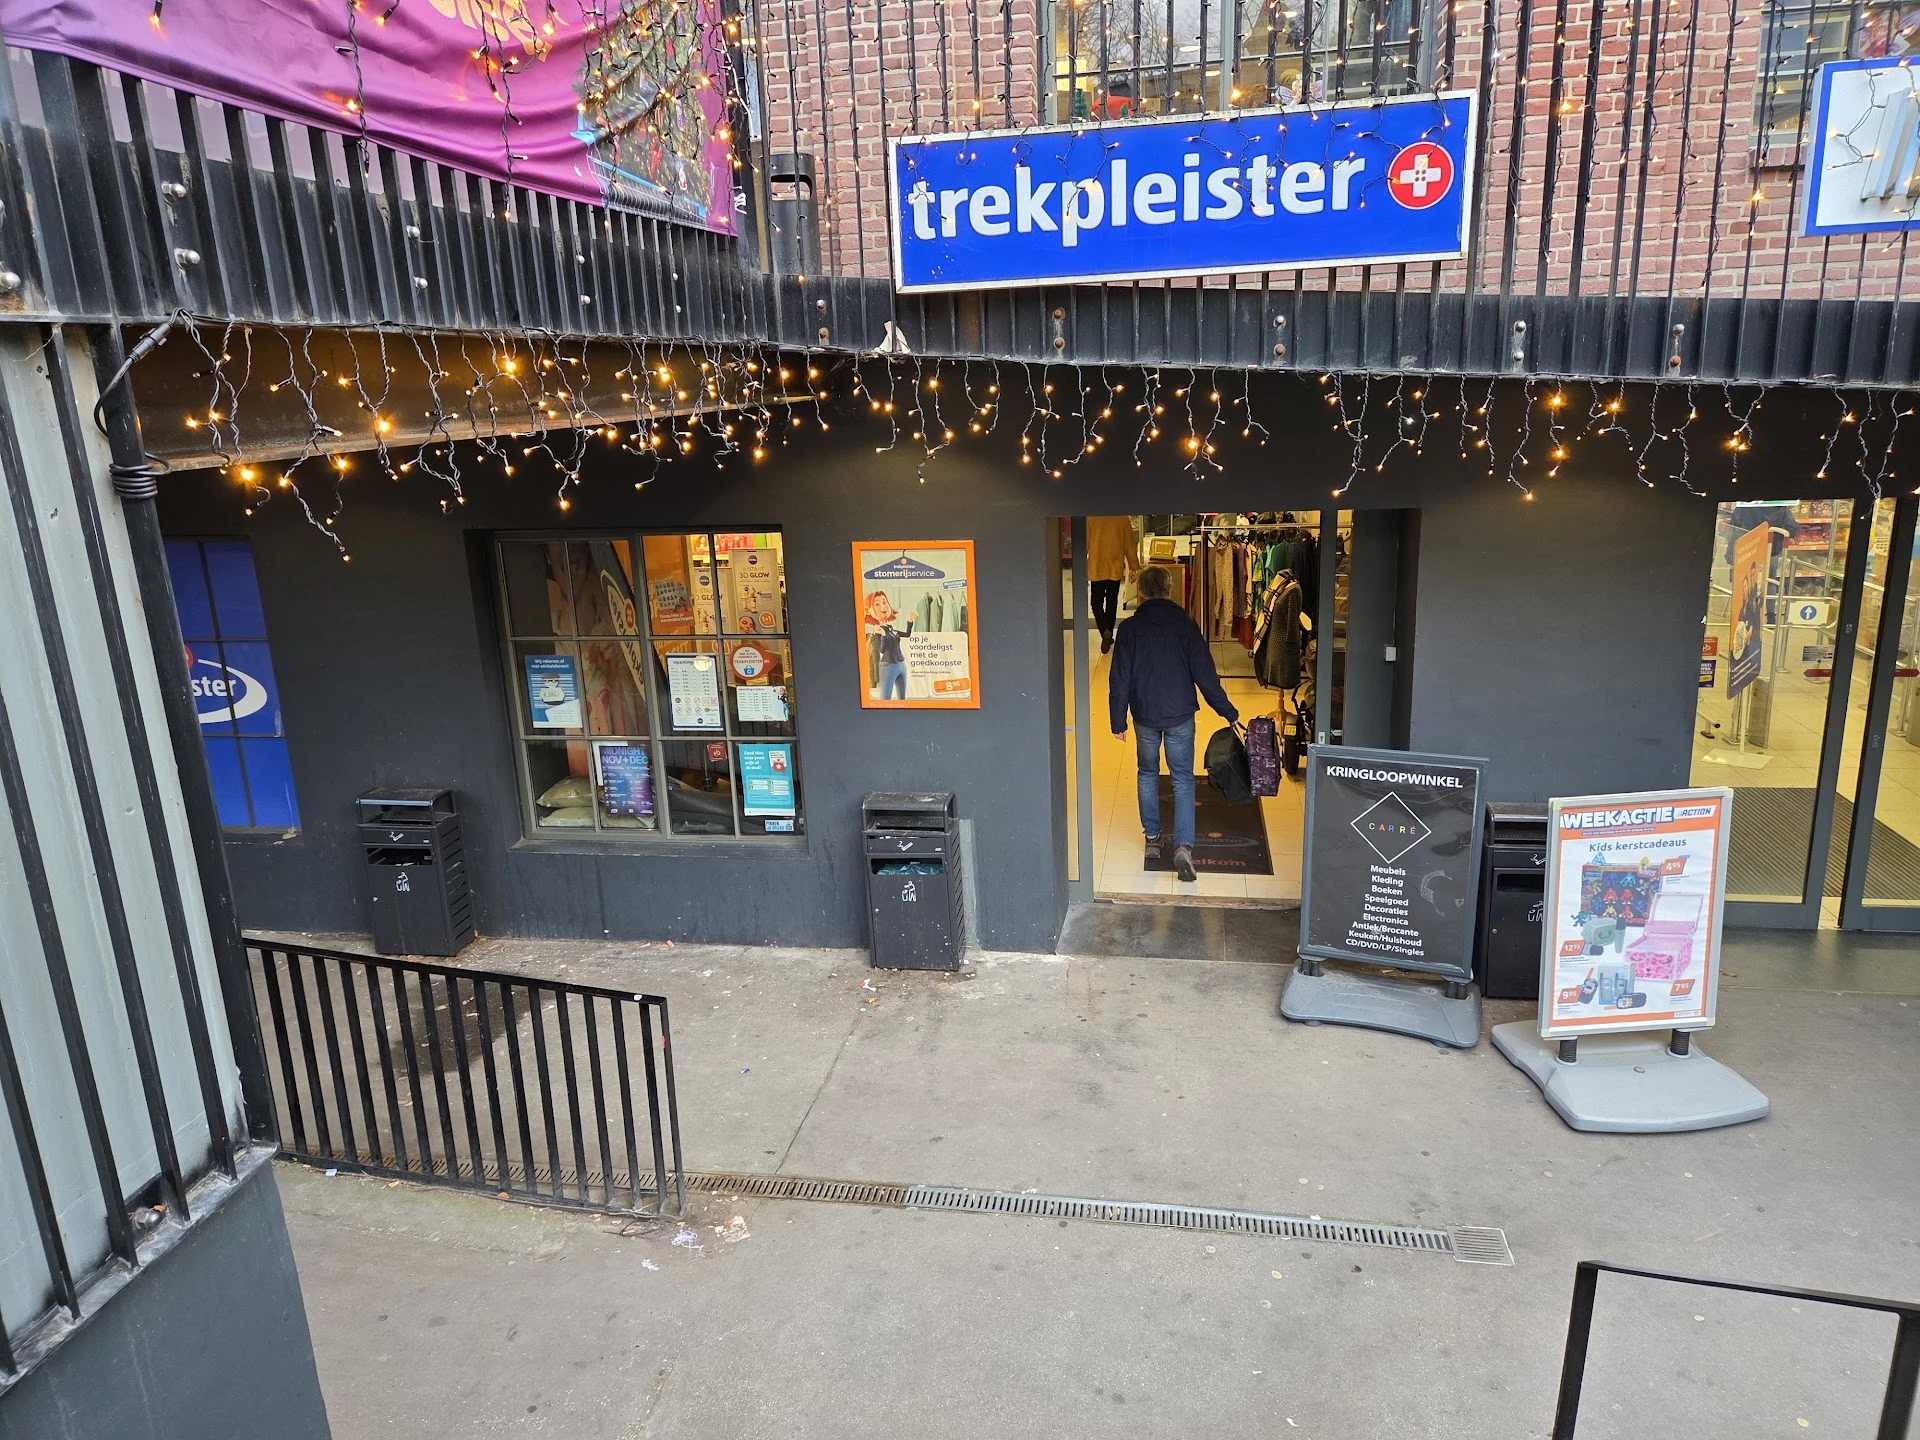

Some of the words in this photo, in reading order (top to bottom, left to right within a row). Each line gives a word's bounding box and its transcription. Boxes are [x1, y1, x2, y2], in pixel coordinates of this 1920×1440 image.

[908, 152, 1366, 248] trekpleister
[874, 570, 934, 578] stomerijservice
[910, 643, 953, 652] voordeligst
[191, 676, 236, 696] ster
[603, 747, 645, 755] MIDNIGHT
[1326, 766, 1463, 788] KRINGLOOPWINKEL
[1563, 806, 1674, 829] WEEKACTIE
[1682, 808, 1711, 817] ACTION
[1368, 822, 1416, 834] CARRÉ
[1589, 842, 1612, 852] Kids
[1616, 838, 1687, 851] kerstcadeaus
[1370, 865, 1406, 876] Meubels
[1666, 861, 1680, 871] 495
[1372, 875, 1404, 887] Kleding
[1372, 885, 1402, 895] Boeken
[1364, 894, 1408, 906] Speelgoed
[1364, 904, 1408, 916] Decoraties
[1363, 914, 1408, 926] Electronica
[1352, 921, 1419, 936] Antiek/Brocante
[1349, 930, 1422, 946] Keuken/Huishoud
[1346, 938, 1424, 956] CD/DVD/LP/Singles
[1675, 983, 1689, 991] 795
[1563, 991, 1576, 999] 995
